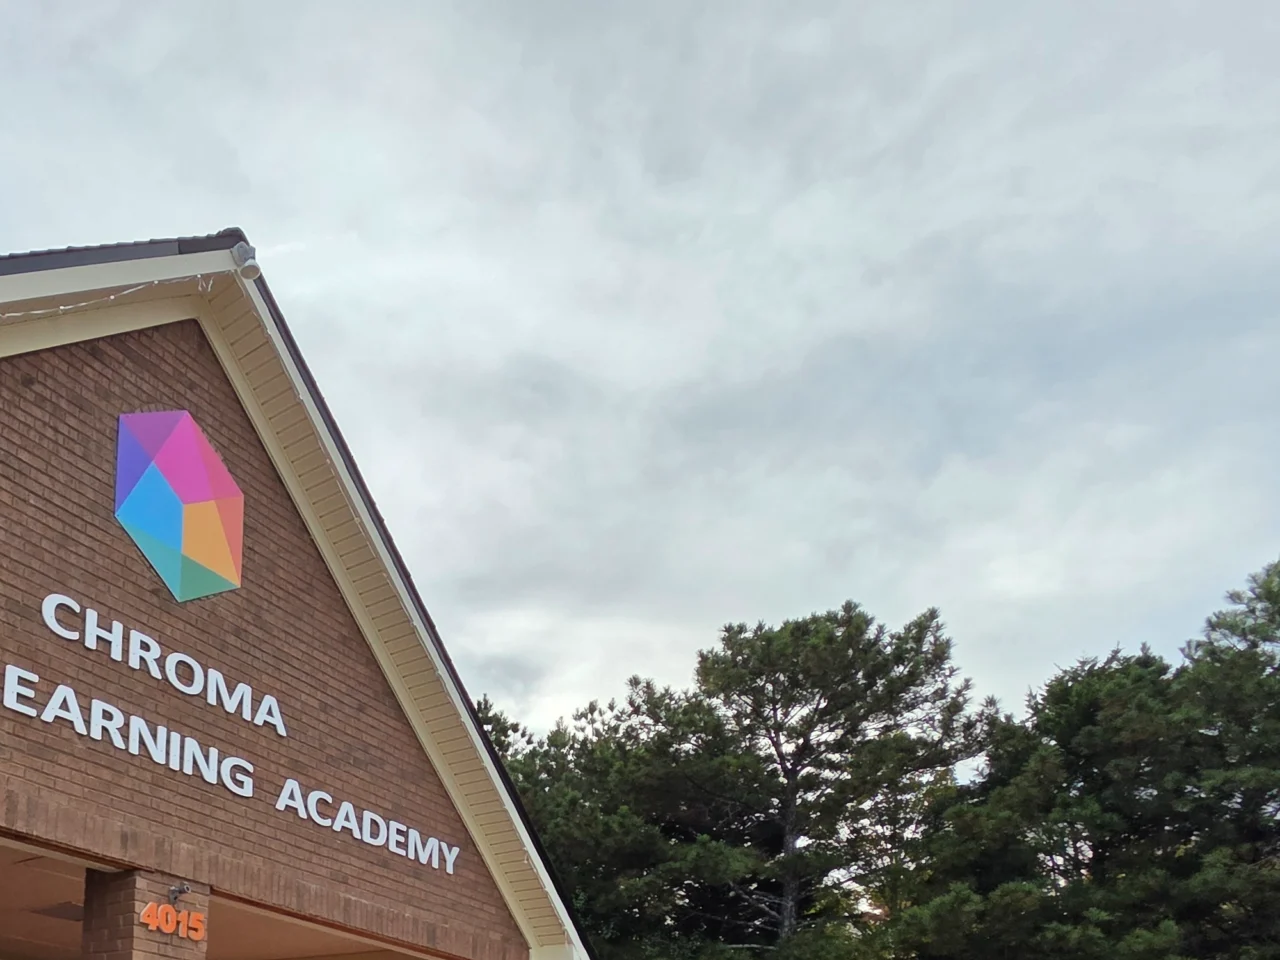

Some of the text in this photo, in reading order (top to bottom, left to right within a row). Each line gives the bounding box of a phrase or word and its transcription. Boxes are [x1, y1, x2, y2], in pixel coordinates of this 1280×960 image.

[42, 594, 286, 736] CHROMA
[276, 779, 460, 875] ACADEMY
[140, 902, 205, 941] 4015
